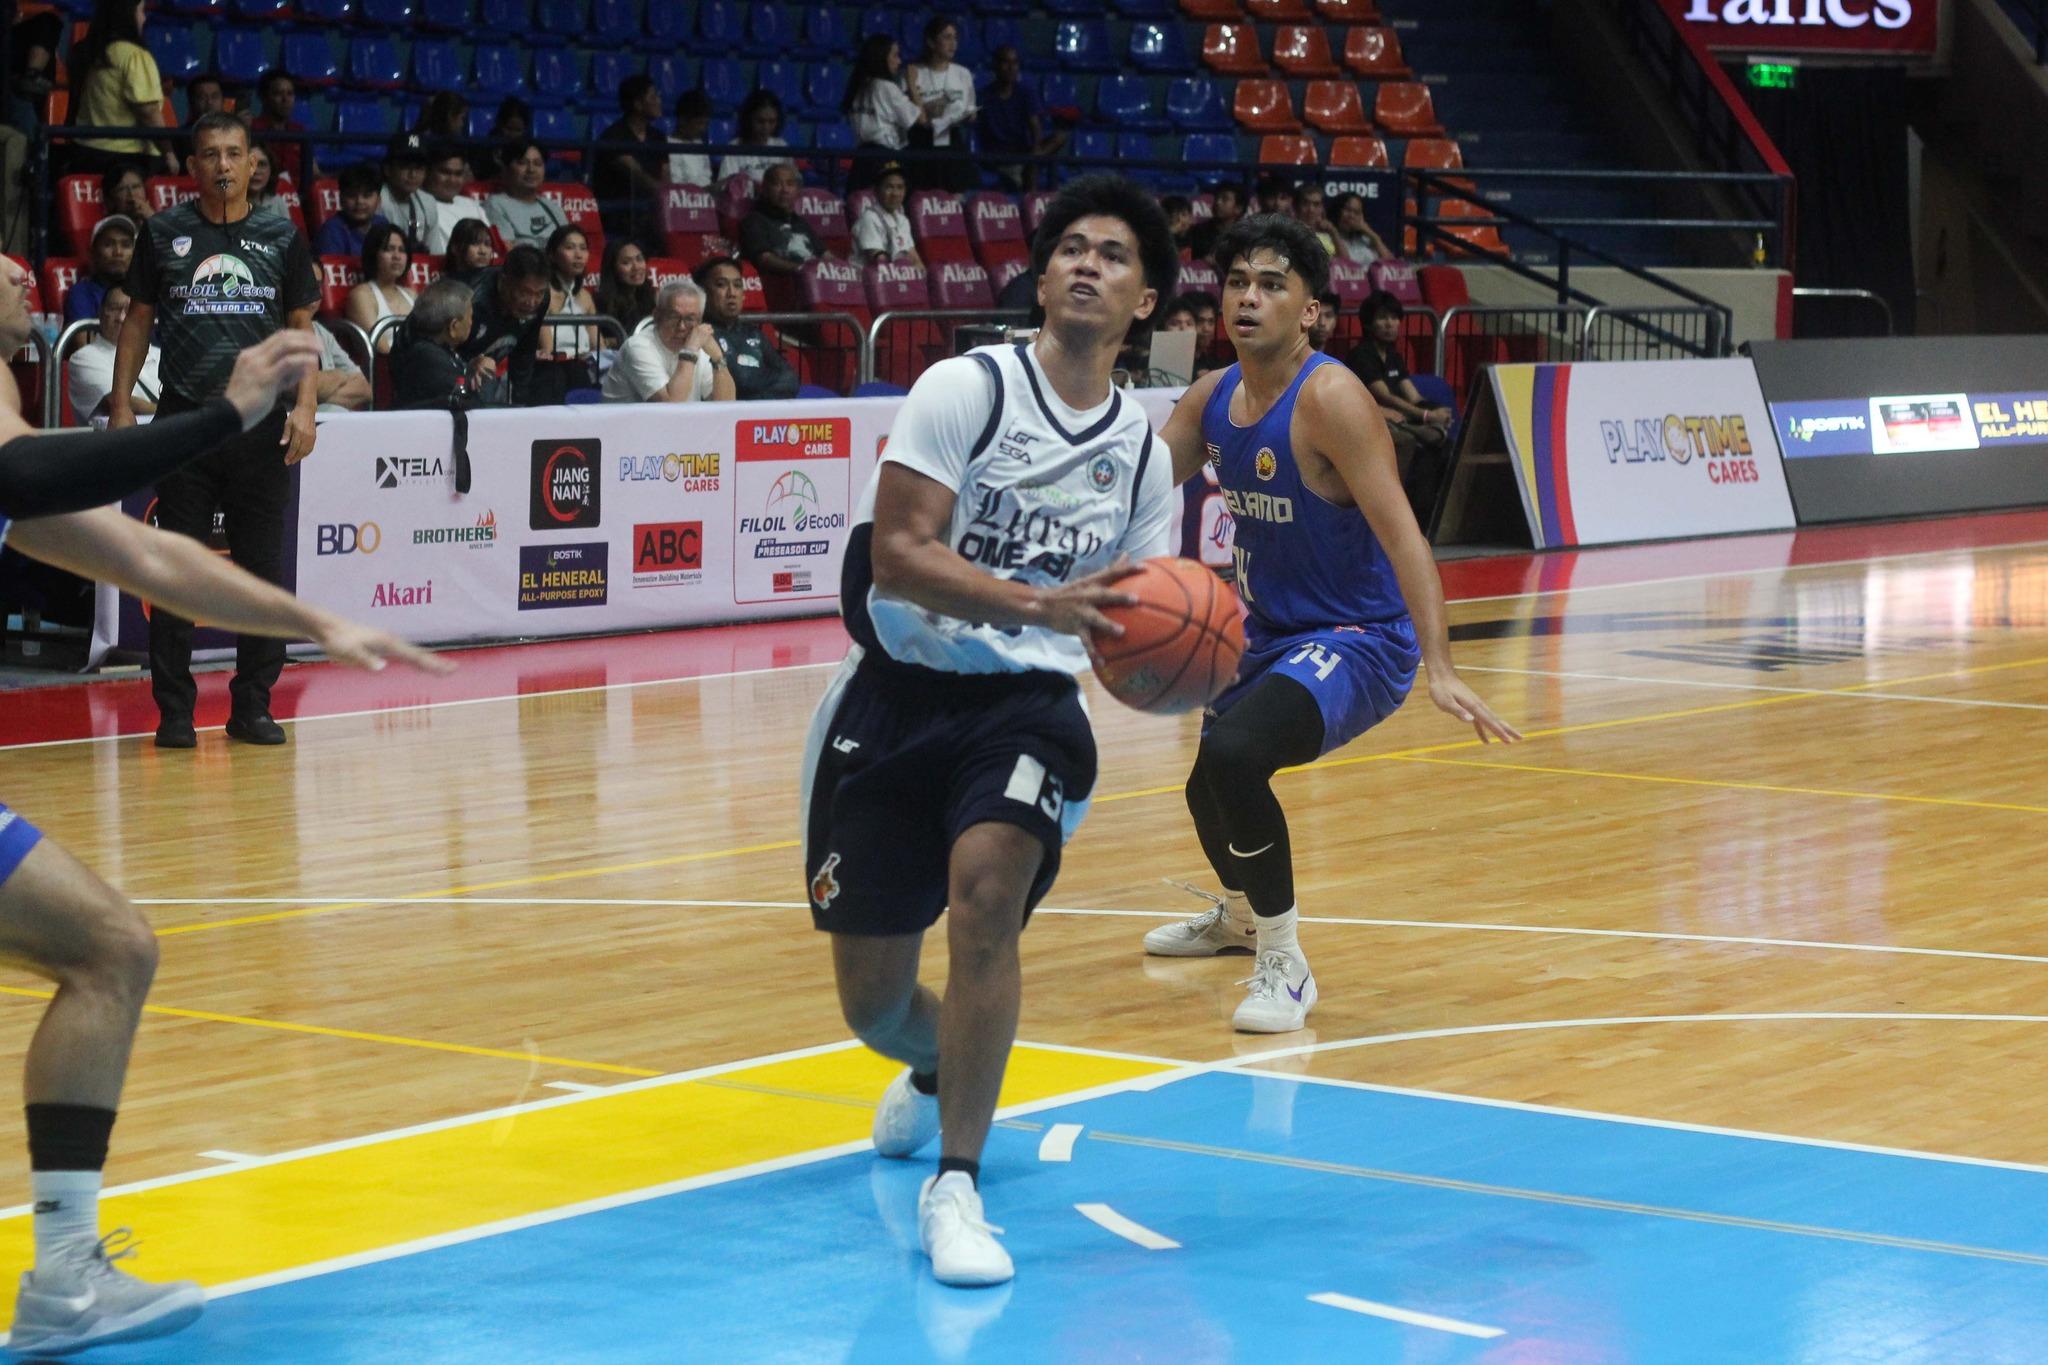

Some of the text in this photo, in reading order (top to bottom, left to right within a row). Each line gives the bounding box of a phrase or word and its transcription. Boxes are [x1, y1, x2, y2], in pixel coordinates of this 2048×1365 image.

[804, 443, 834, 456] CARES
[552, 466, 590, 485] JIANG
[1707, 460, 1760, 485] CARES
[552, 484, 582, 501] NAN
[684, 479, 720, 493] CARES
[740, 513, 845, 534] FILOIL EcoOil
[316, 520, 382, 556] BDO
[412, 526, 494, 545] BROTHERS
[553, 549, 582, 560] BOSTIK
[638, 528, 698, 566] ABC
[757, 543, 828, 557] PRESEASON CUP
[521, 569, 606, 589] EL HENERAL
[370, 580, 433, 608] Akari
[521, 587, 605, 603] ALL-PURPOSE EPOXY
